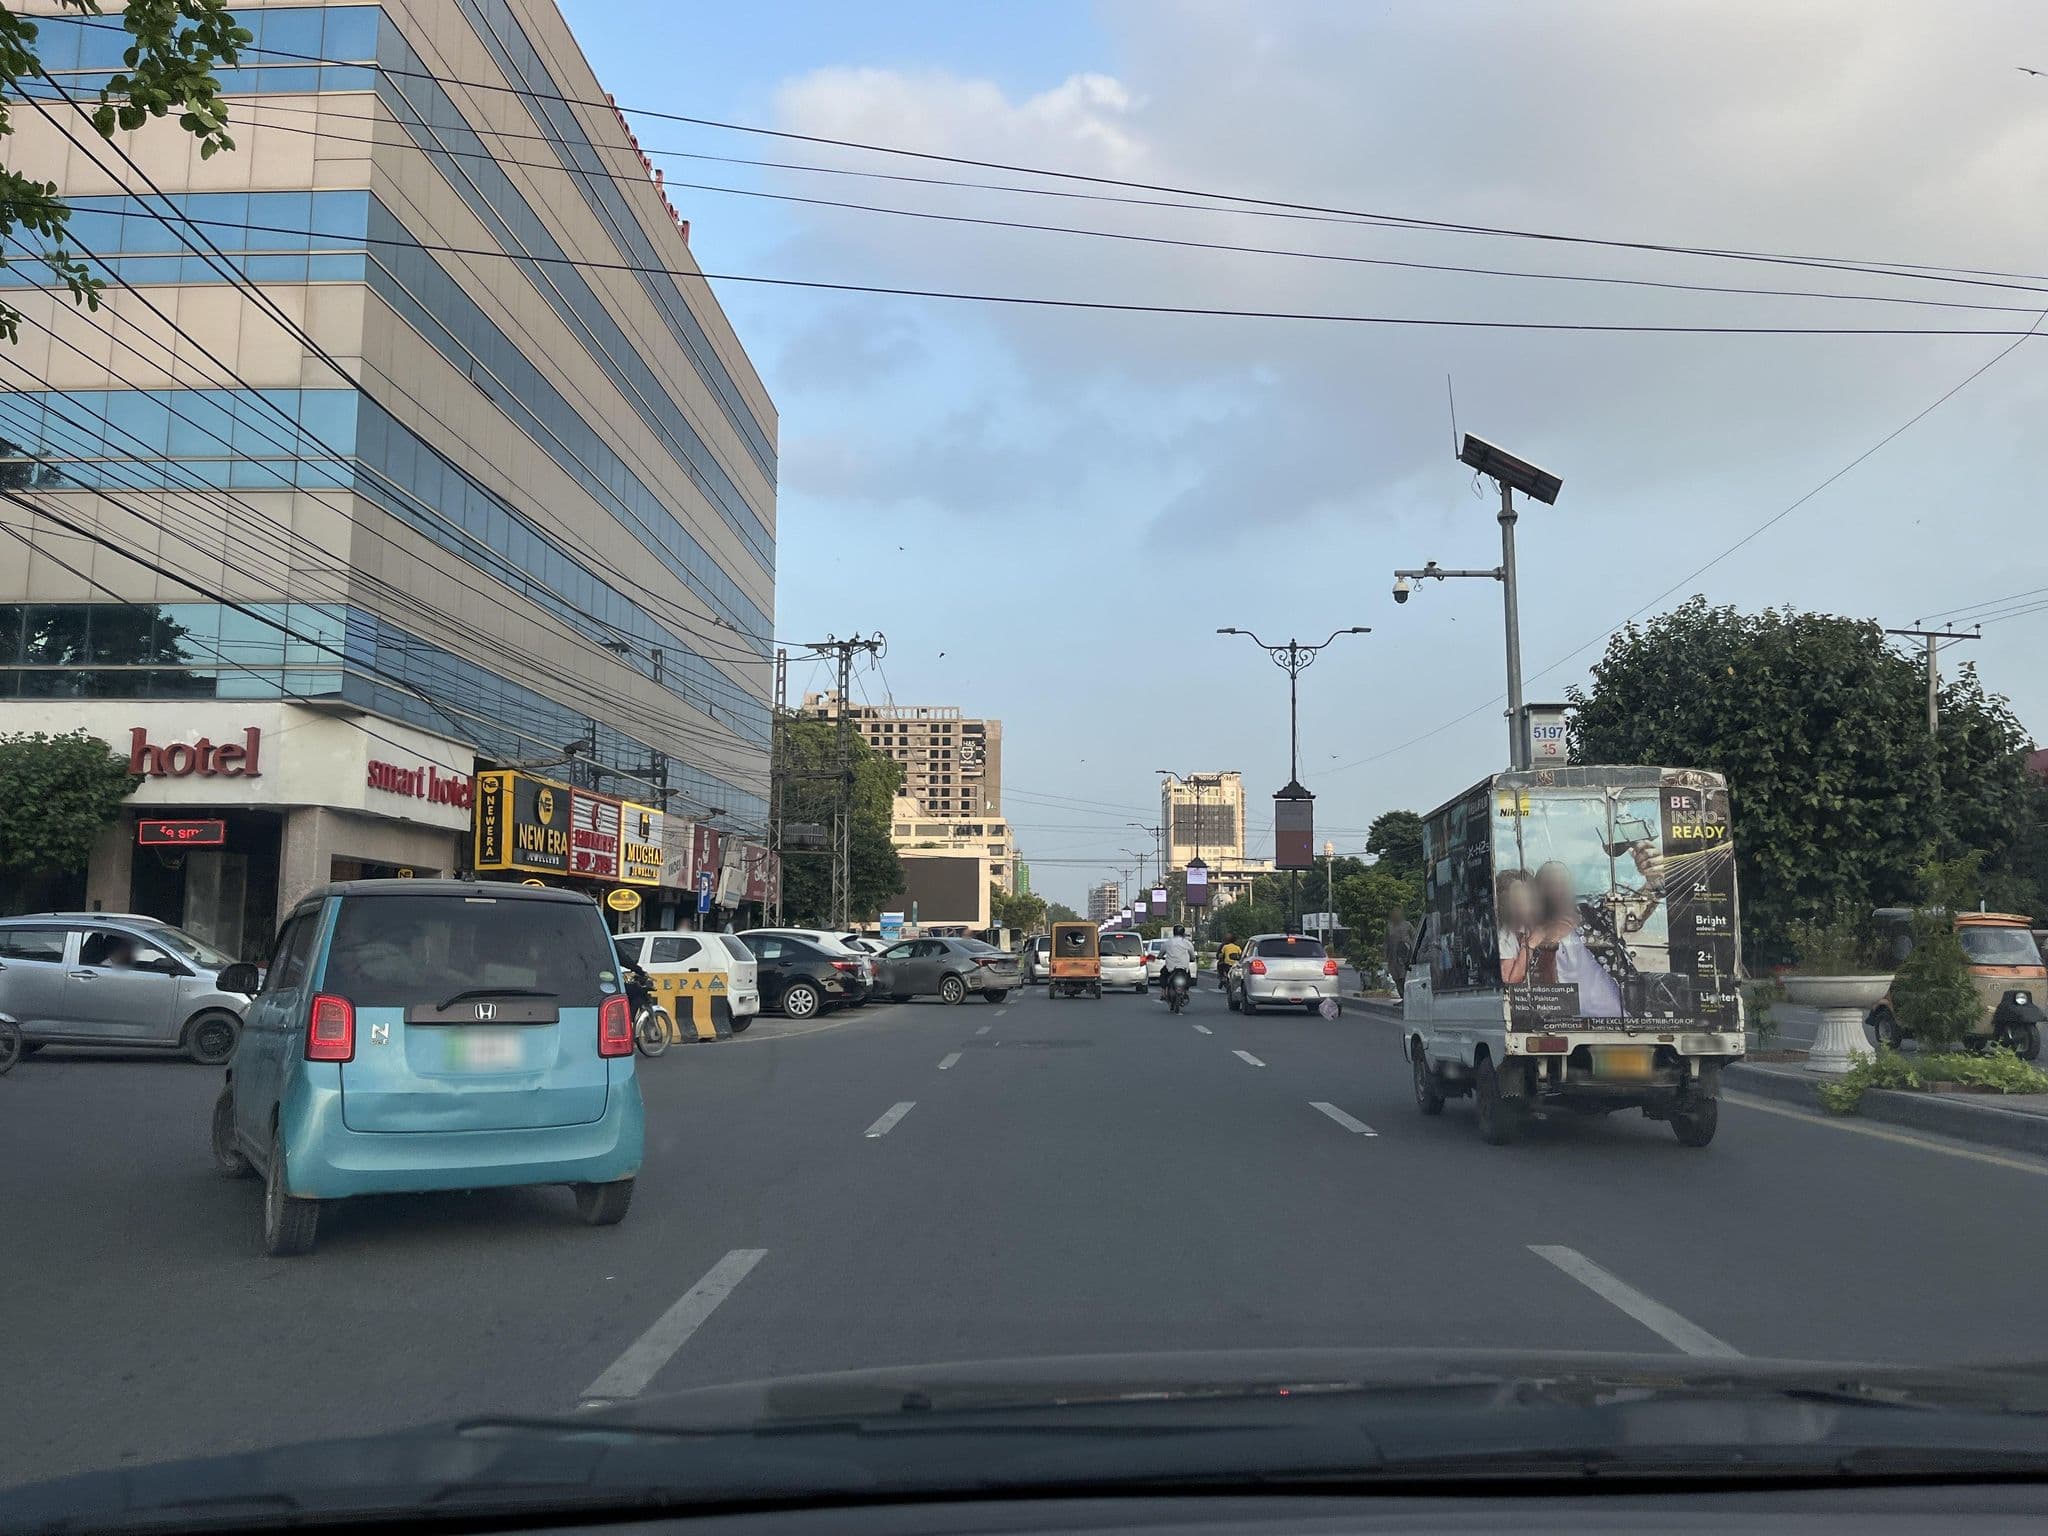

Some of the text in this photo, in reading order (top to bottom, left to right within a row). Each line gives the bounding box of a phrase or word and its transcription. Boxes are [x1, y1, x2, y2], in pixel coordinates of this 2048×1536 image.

[1533, 726, 1564, 739] 5197
[129, 727, 262, 777] hotel
[1542, 743, 1557, 755] 15
[368, 760, 474, 809] smart hotel
[1670, 796, 1691, 809] BE
[1672, 825, 1726, 839] READY
[519, 822, 545, 852] NEW
[547, 829, 569, 856] ERA
[626, 842, 664, 866] MUGHAL
[1693, 882, 1707, 892] 2x
[1695, 915, 1727, 927] Bright
[1697, 950, 1713, 962] 2+
